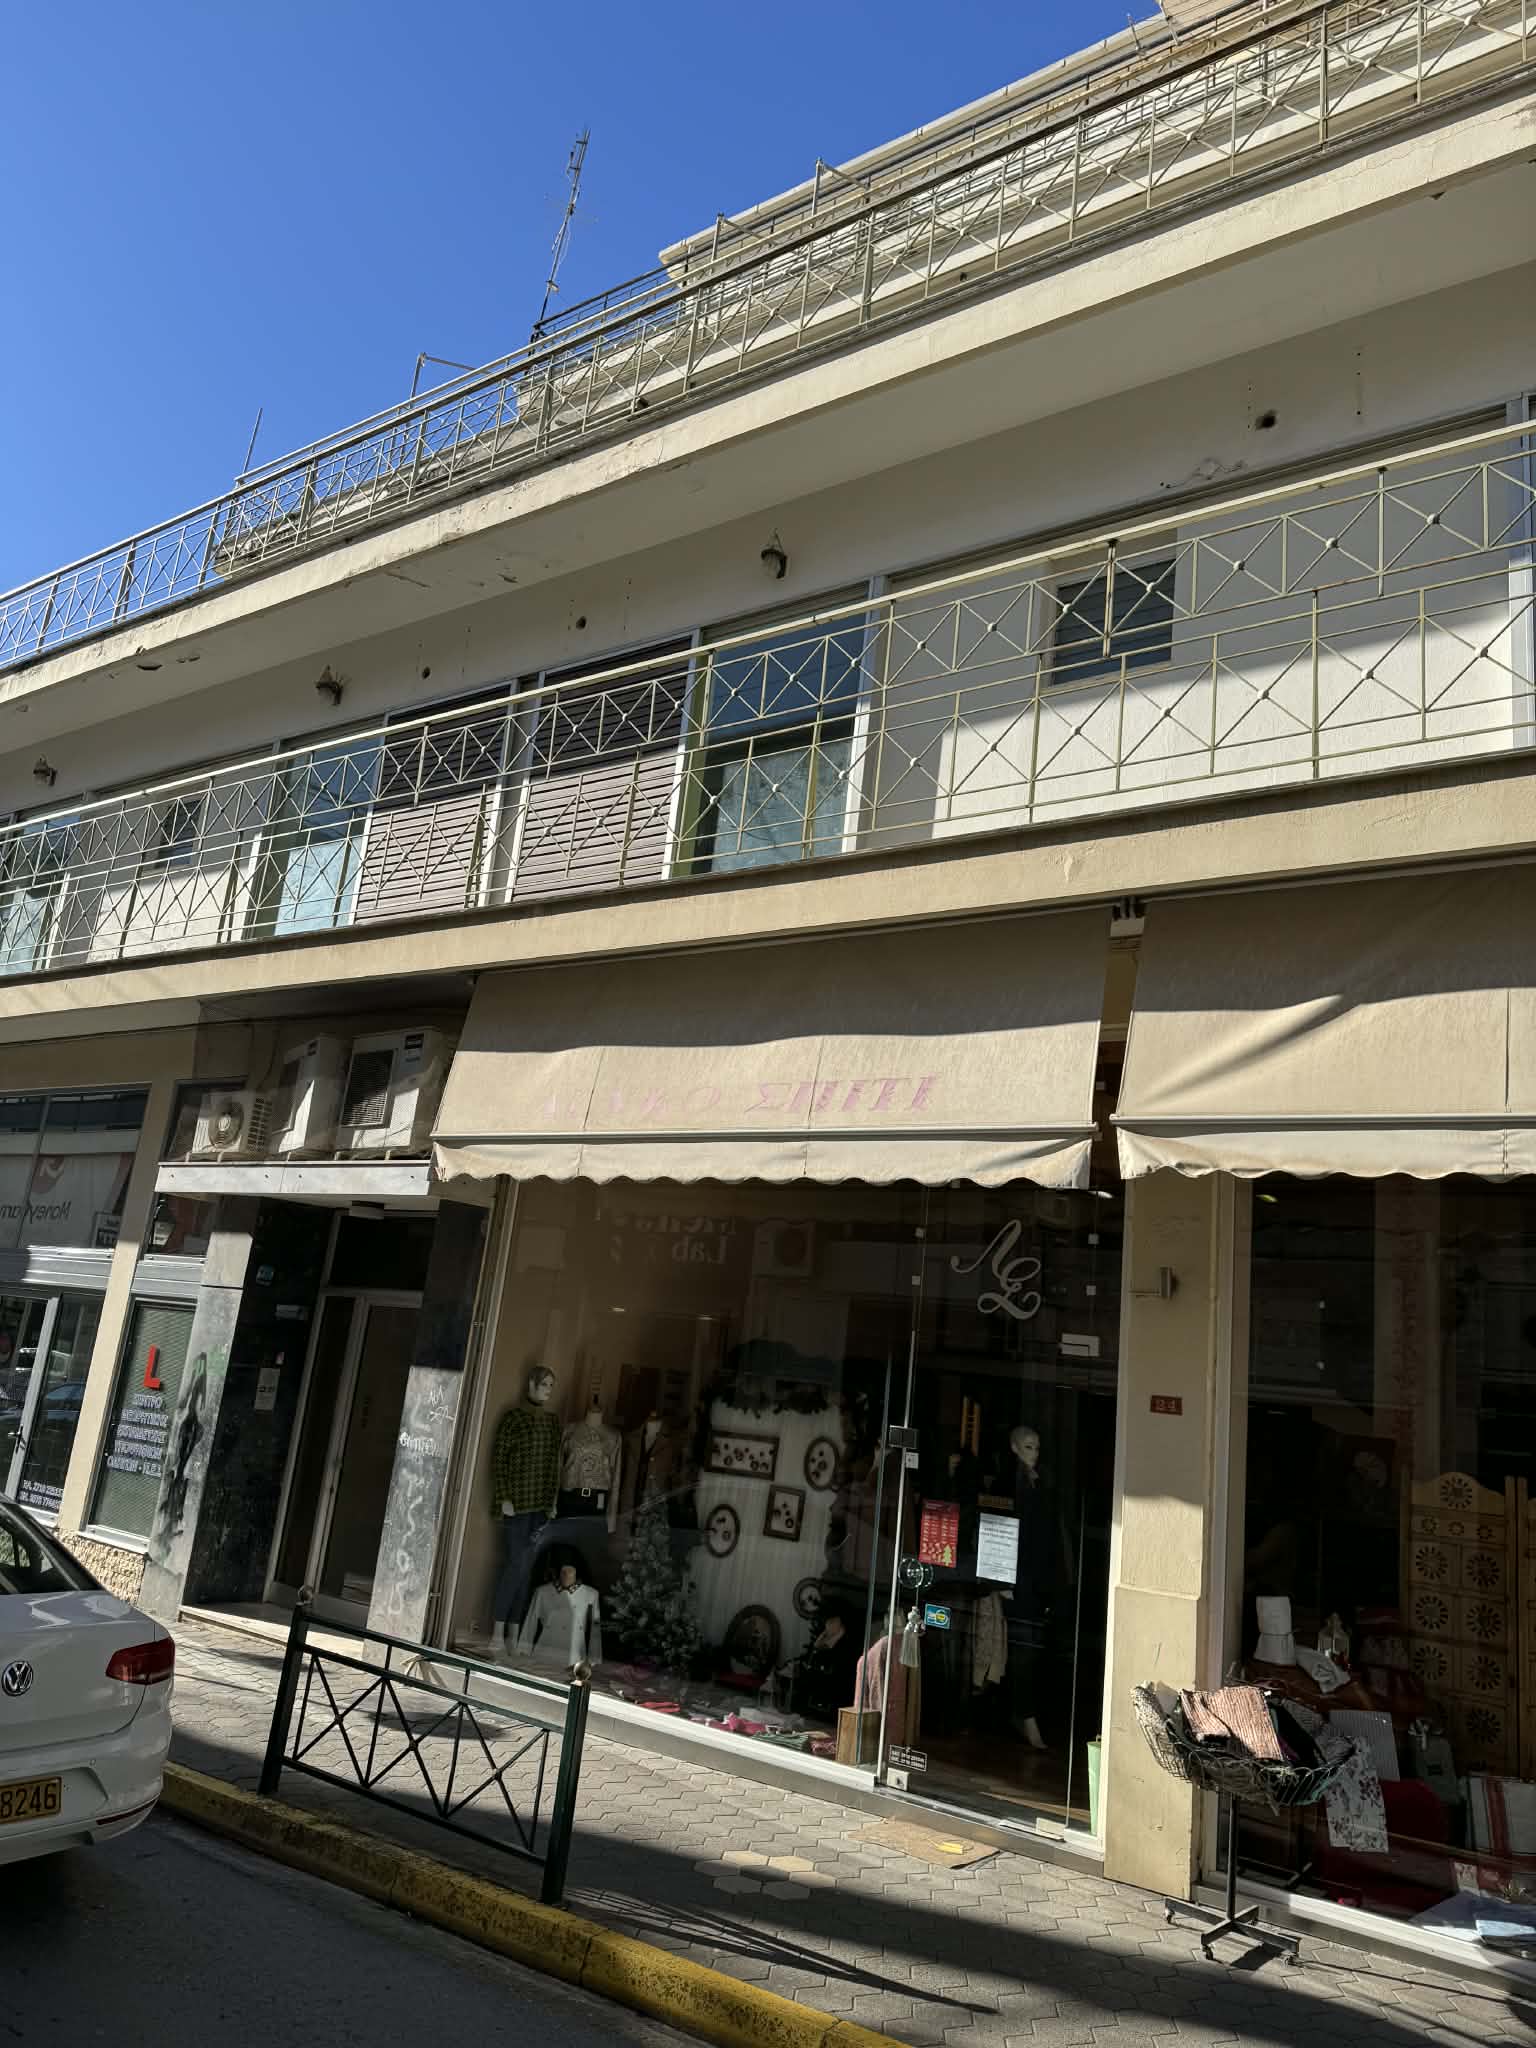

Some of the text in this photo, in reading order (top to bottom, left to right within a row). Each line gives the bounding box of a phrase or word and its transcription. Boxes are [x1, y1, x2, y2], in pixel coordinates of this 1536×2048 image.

[744, 1073, 939, 1114] ΣΠΙΤΙ
[143, 1343, 161, 1390] L
[0, 1783, 57, 1818] 8246
